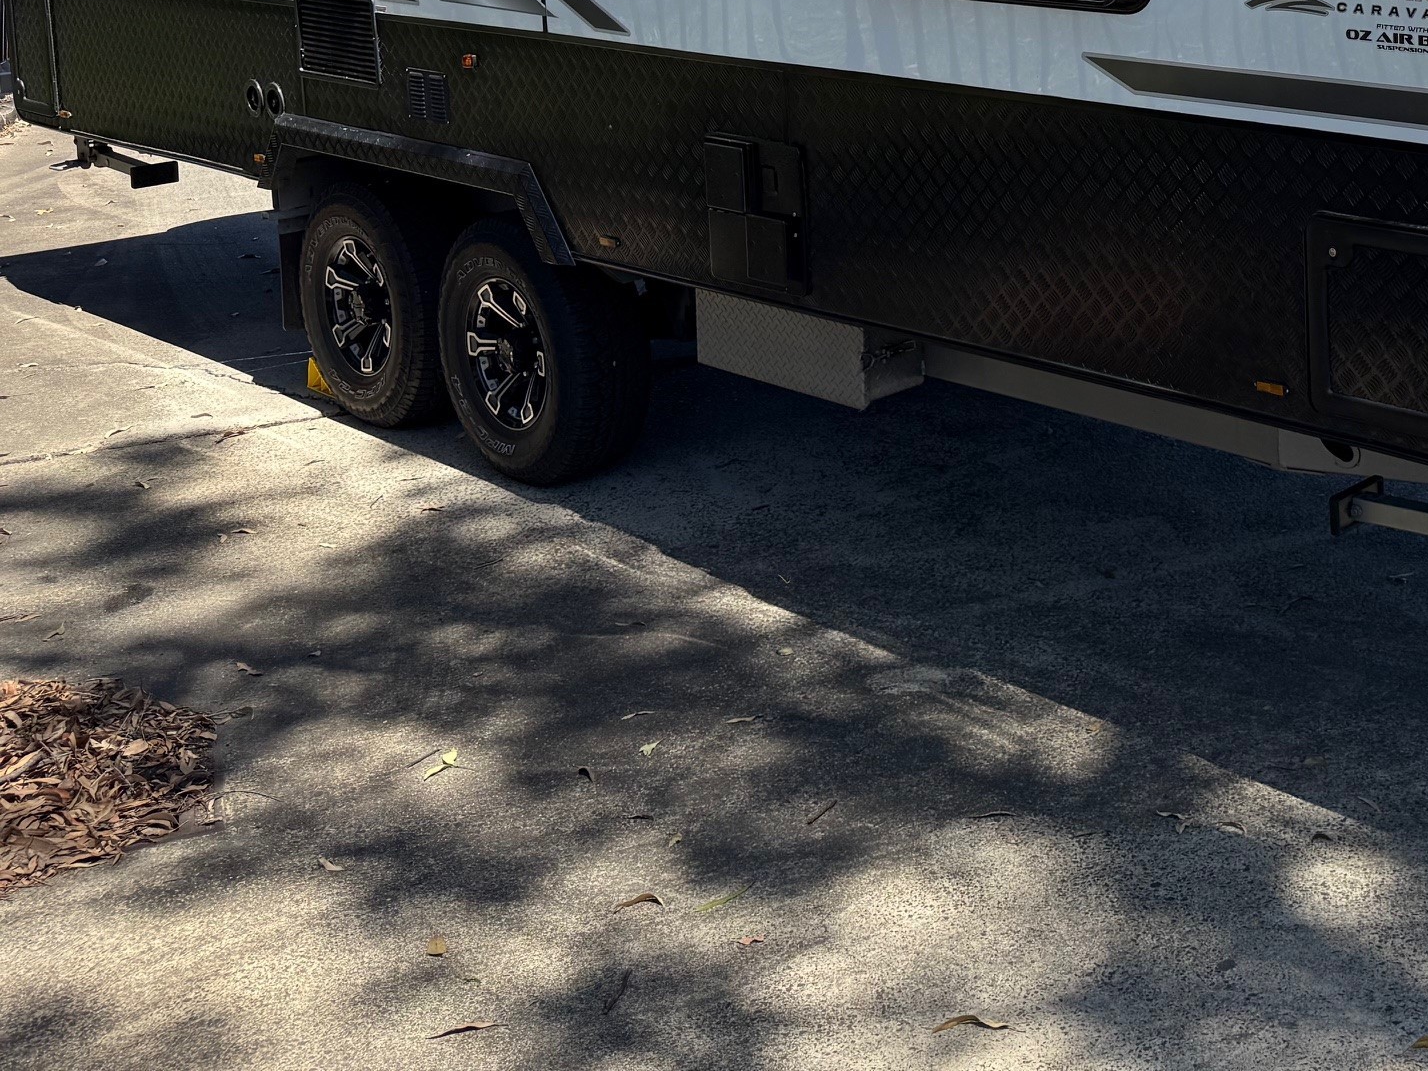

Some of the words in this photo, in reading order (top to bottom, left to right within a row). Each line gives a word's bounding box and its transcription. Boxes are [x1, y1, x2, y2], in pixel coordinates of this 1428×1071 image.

[1376, 23, 1405, 32] FITTED
[1346, 28, 1372, 41] OZ
[1376, 32, 1415, 45] AIR
